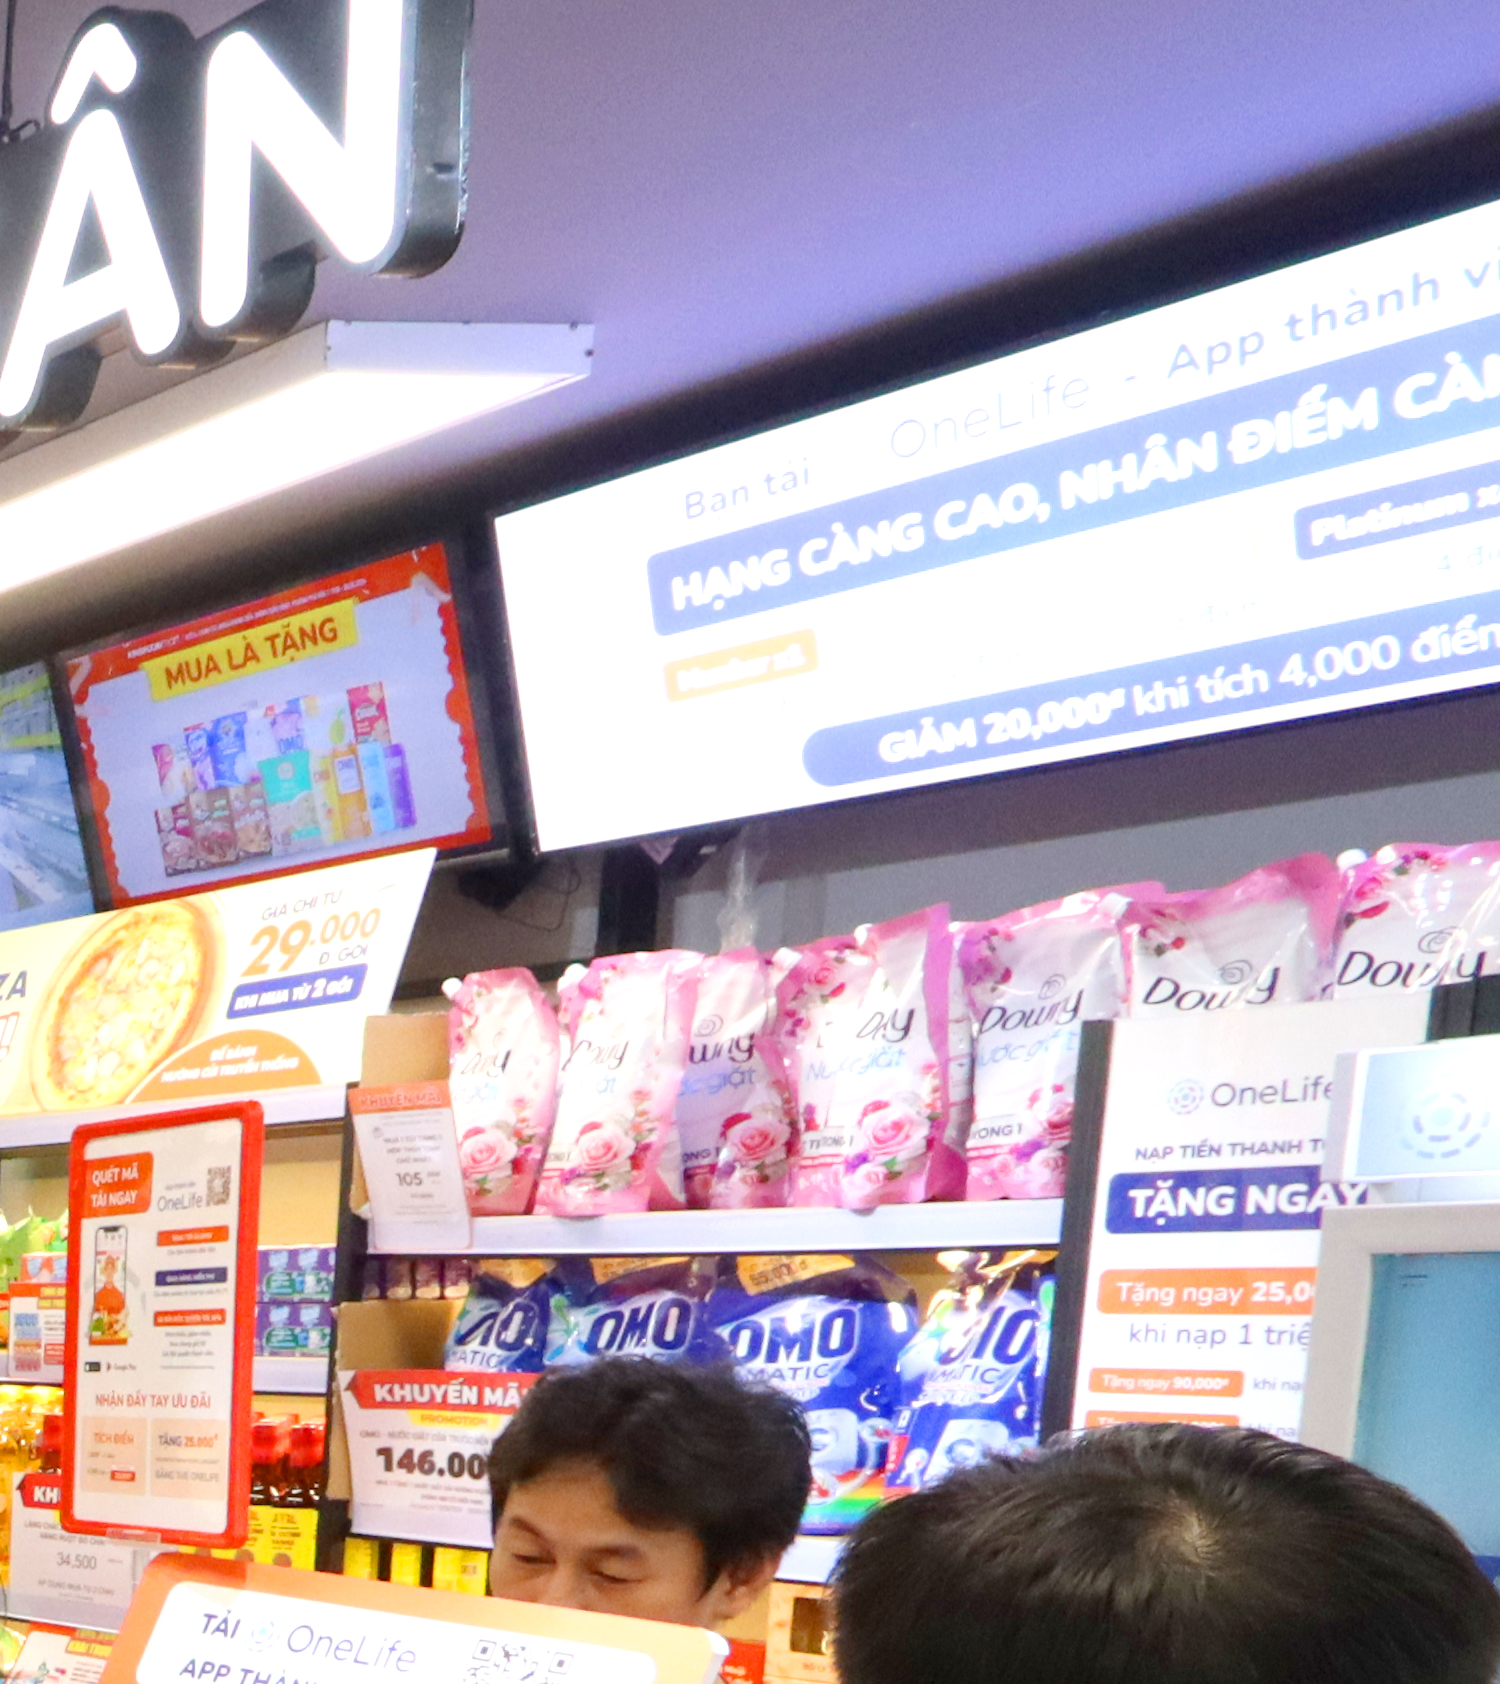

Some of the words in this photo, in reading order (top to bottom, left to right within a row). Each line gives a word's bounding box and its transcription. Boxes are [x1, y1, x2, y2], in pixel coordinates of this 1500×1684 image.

[888, 372, 1092, 463] OneLife
[1167, 330, 1265, 380] App
[1284, 271, 1440, 343] thành
[671, 549, 791, 610] HẠNG
[798, 521, 925, 577] CÀNG
[934, 482, 1051, 541] CAO,
[1059, 433, 1218, 510] NHÂN
[164, 654, 223, 689] MUA
[227, 634, 260, 671] LÀ
[264, 617, 339, 663] TẶNG
[878, 717, 977, 763] GIẢM
[1133, 675, 1189, 716] khi
[1196, 665, 1270, 704] tích
[1279, 635, 1400, 688] 4,000
[240, 907, 381, 977] 29.000
[312, 978, 326, 998] 2
[1211, 1075, 1332, 1108] OneLife
[1136, 1147, 1173, 1164] NẠP
[1181, 1139, 1222, 1159] TIỀN
[1226, 1140, 1303, 1155] THANH
[122, 1162, 139, 1180] MÃ
[158, 1193, 202, 1212] OneLife
[1128, 1179, 1235, 1226] TẶNG
[1116, 1281, 1175, 1308] Tặng
[1182, 1285, 1243, 1309] ngay
[728, 1308, 857, 1364] OMO
[1129, 1323, 1166, 1344] khi
[1176, 1327, 1226, 1350] nạp
[1238, 1324, 1251, 1345] 1
[373, 1378, 479, 1405] KHUYẾN
[483, 1382, 529, 1408] MÃ
[1102, 1374, 1135, 1391] Tặng
[1137, 1378, 1169, 1391] ngay
[1253, 1377, 1276, 1391] khi
[201, 1609, 241, 1639] TẢI
[287, 1624, 417, 1673] OneLife
[179, 1657, 231, 1683] APP
